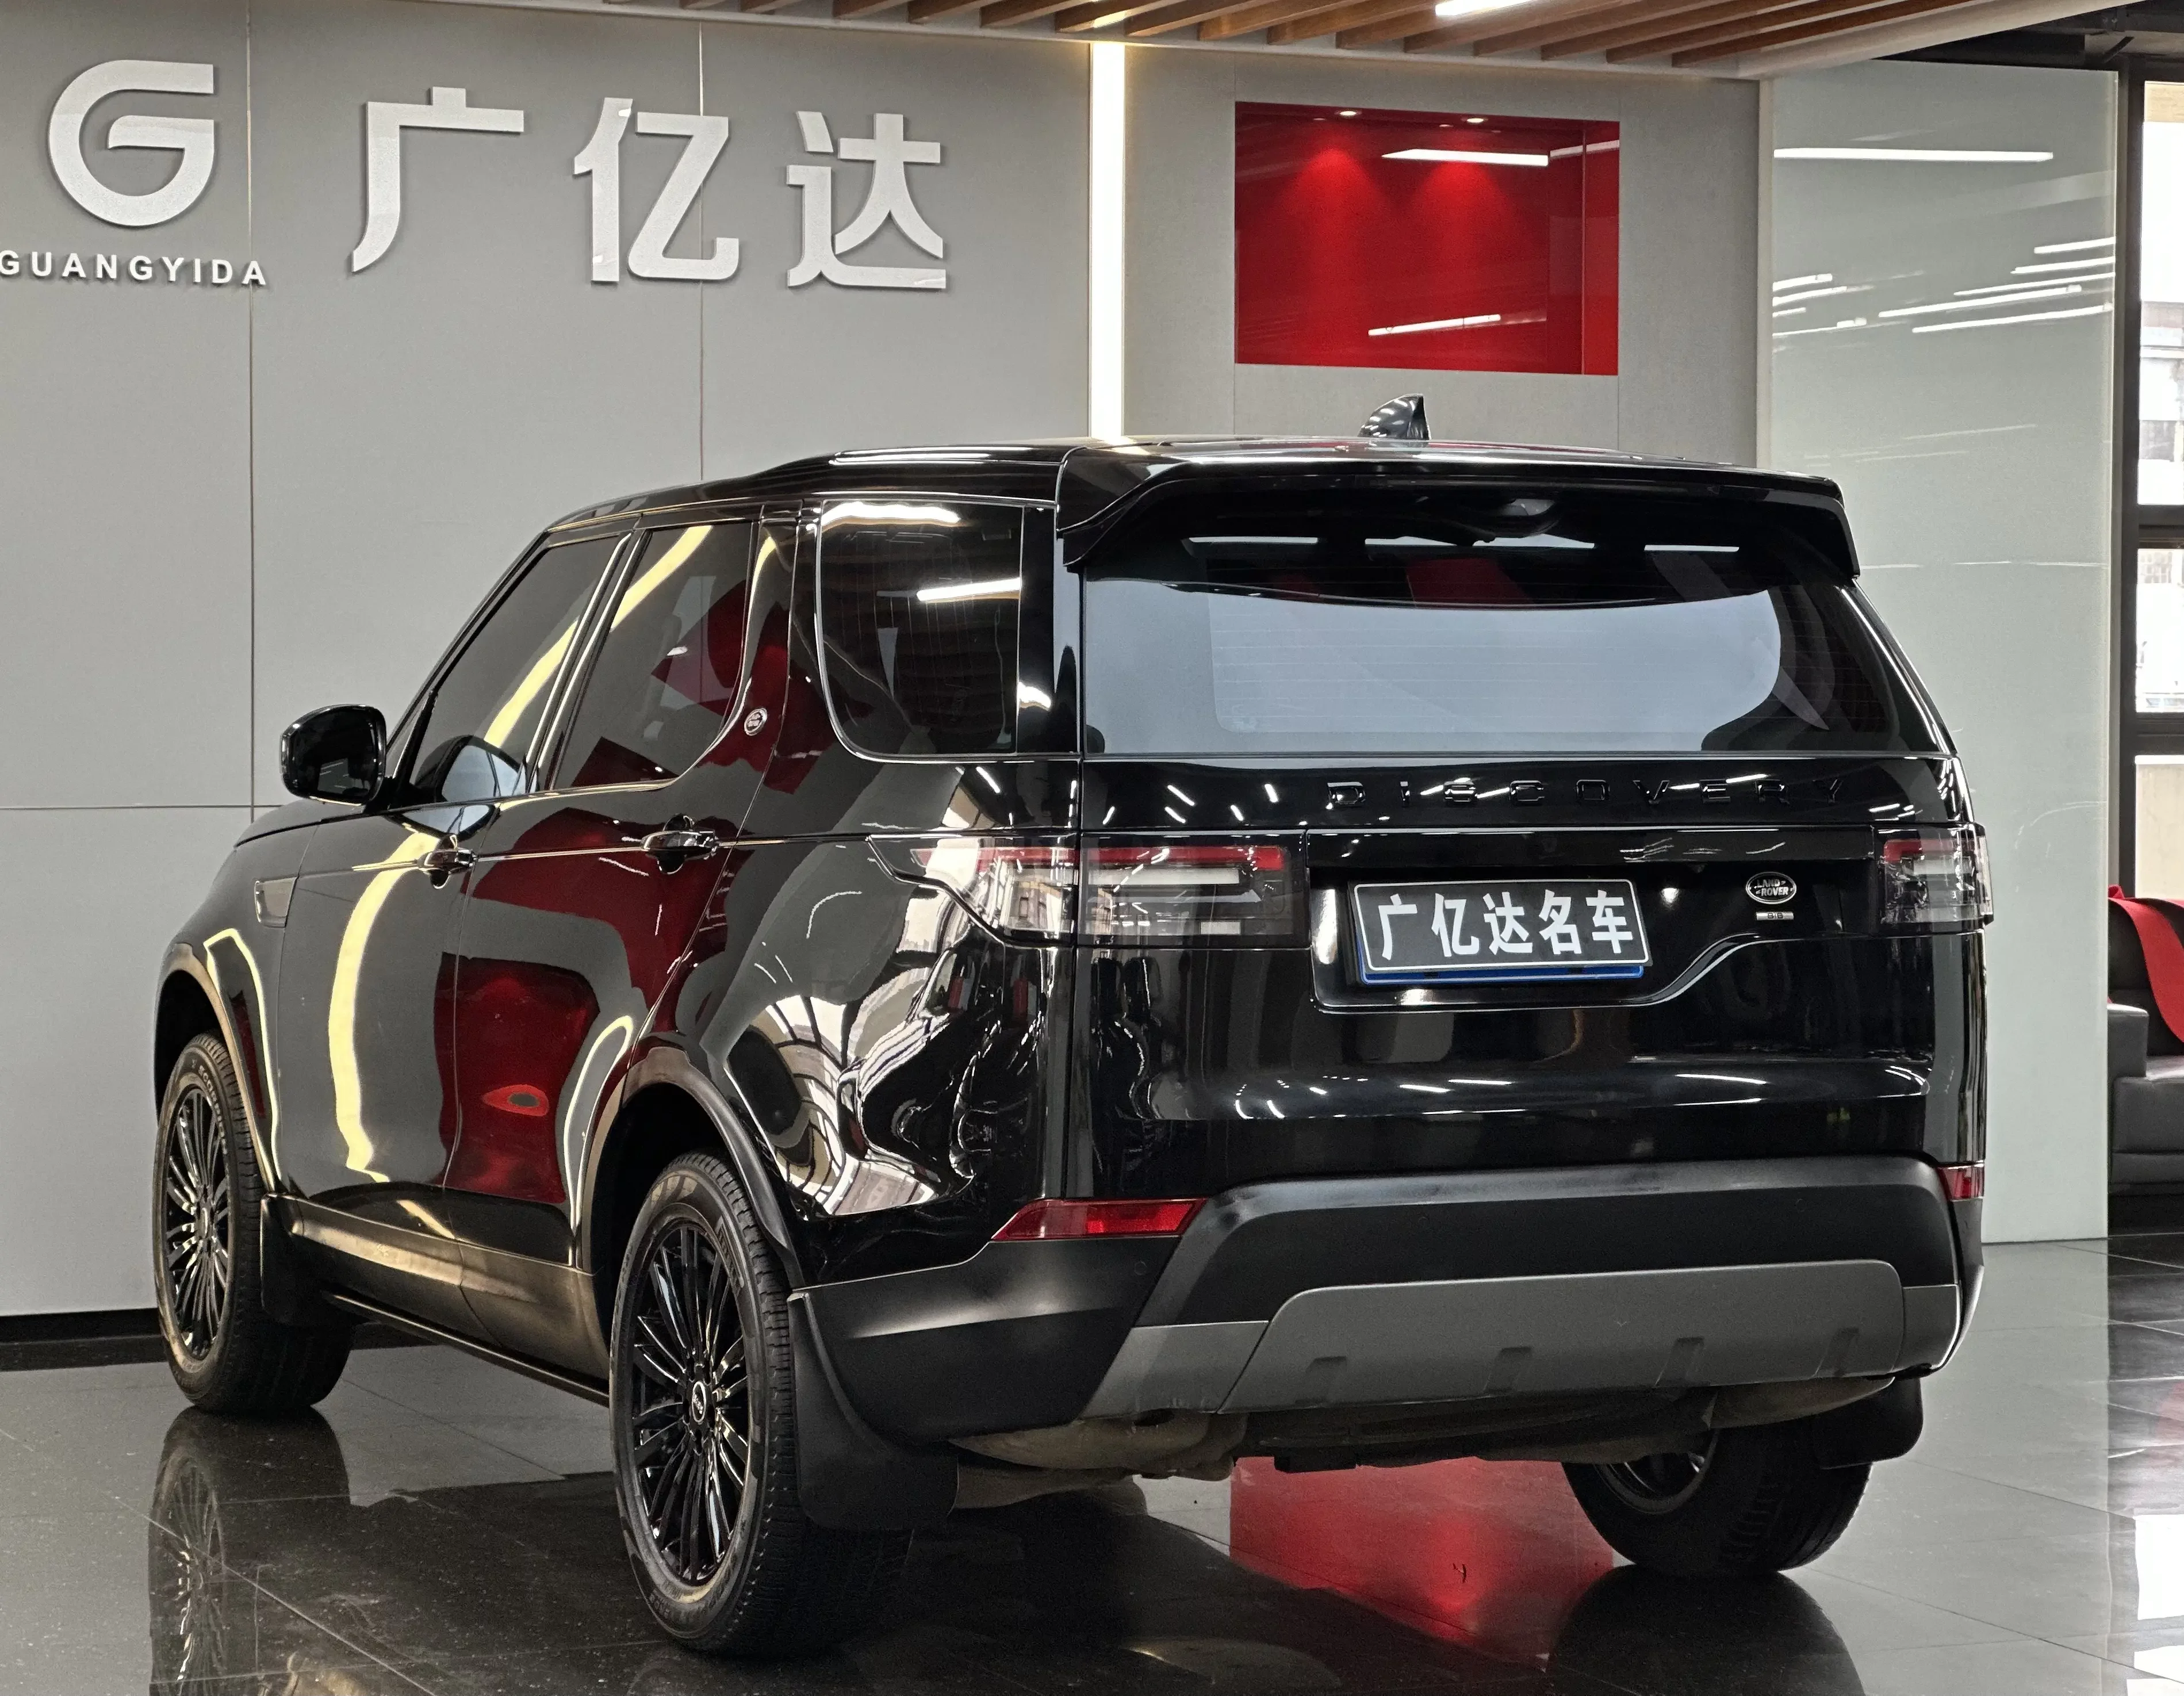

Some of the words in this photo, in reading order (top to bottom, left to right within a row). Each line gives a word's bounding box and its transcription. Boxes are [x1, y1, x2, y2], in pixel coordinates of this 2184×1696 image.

[351, 86, 947, 289] 广亿达
[0, 250, 266, 285] GUANGYIDA
[1326, 779, 1844, 806] DISCOVERY
[1757, 879, 1780, 888] LAND
[1761, 886, 1789, 897] ROVER
[1378, 889, 1633, 960] 广亿达名车
